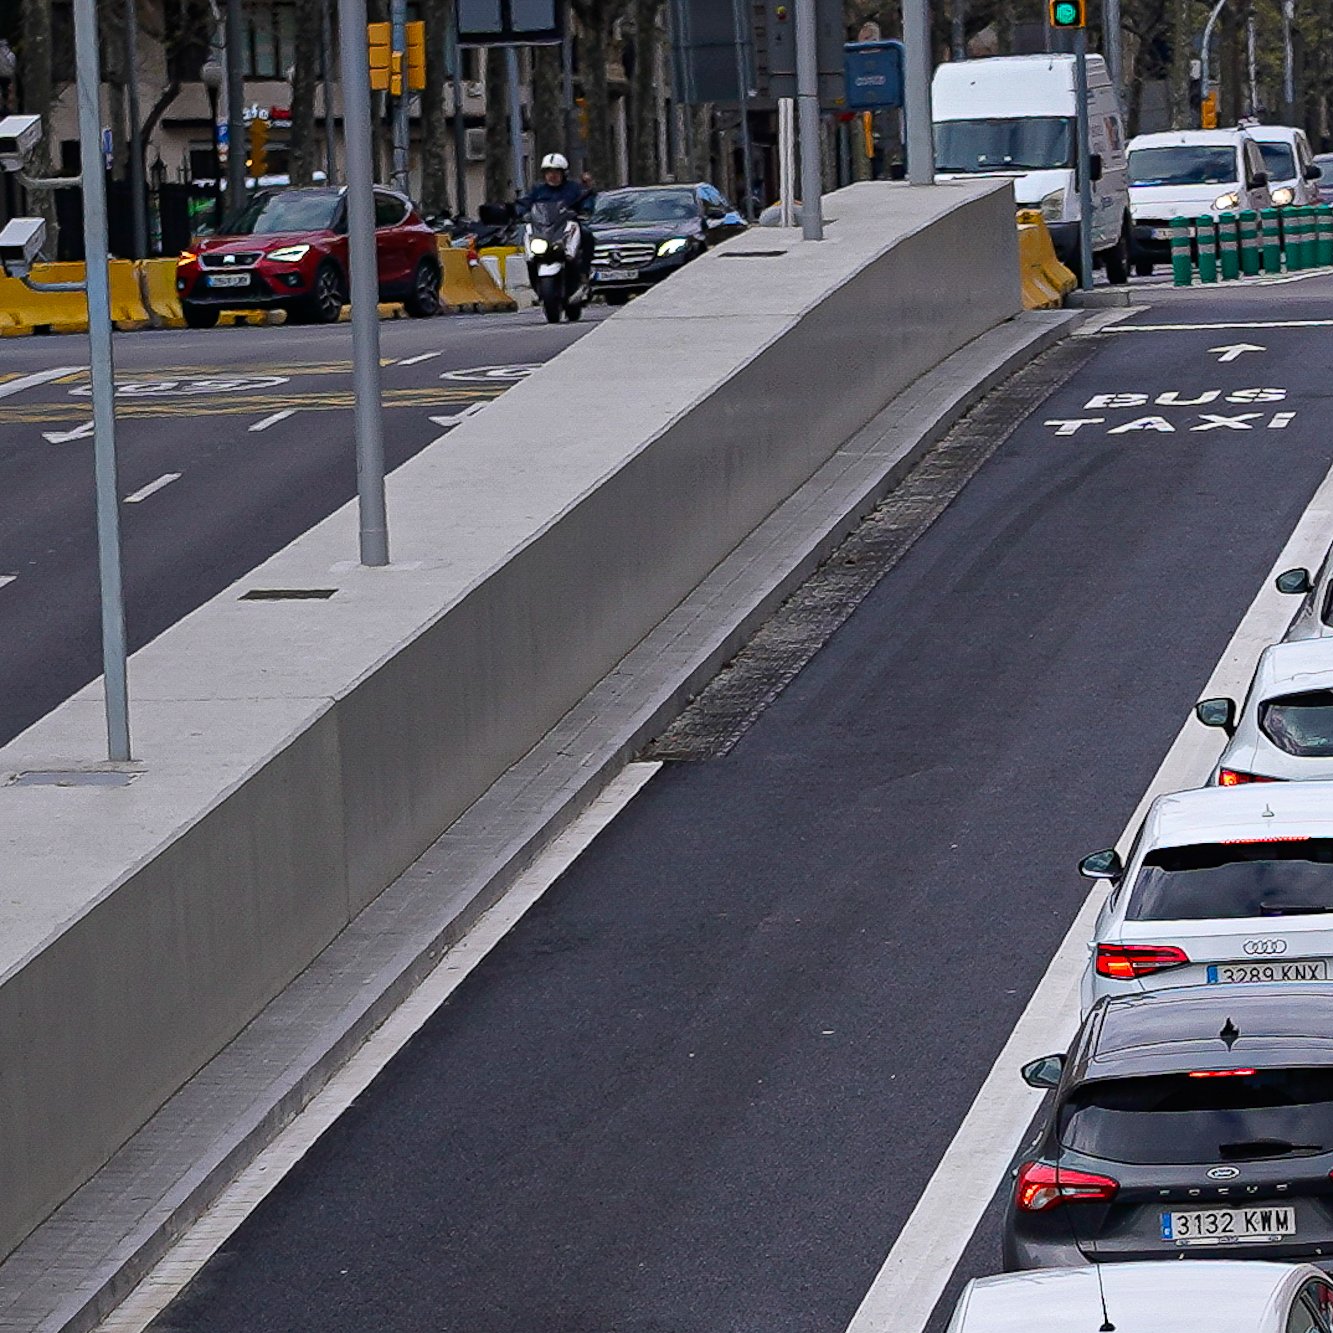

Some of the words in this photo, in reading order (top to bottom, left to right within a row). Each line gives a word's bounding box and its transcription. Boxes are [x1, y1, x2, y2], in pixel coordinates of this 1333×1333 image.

[1083, 388, 1287, 409] BUS
[1044, 412, 1297, 436] TAXI
[1176, 1212, 1234, 1236] 3132
[1244, 1209, 1289, 1233] KWM
